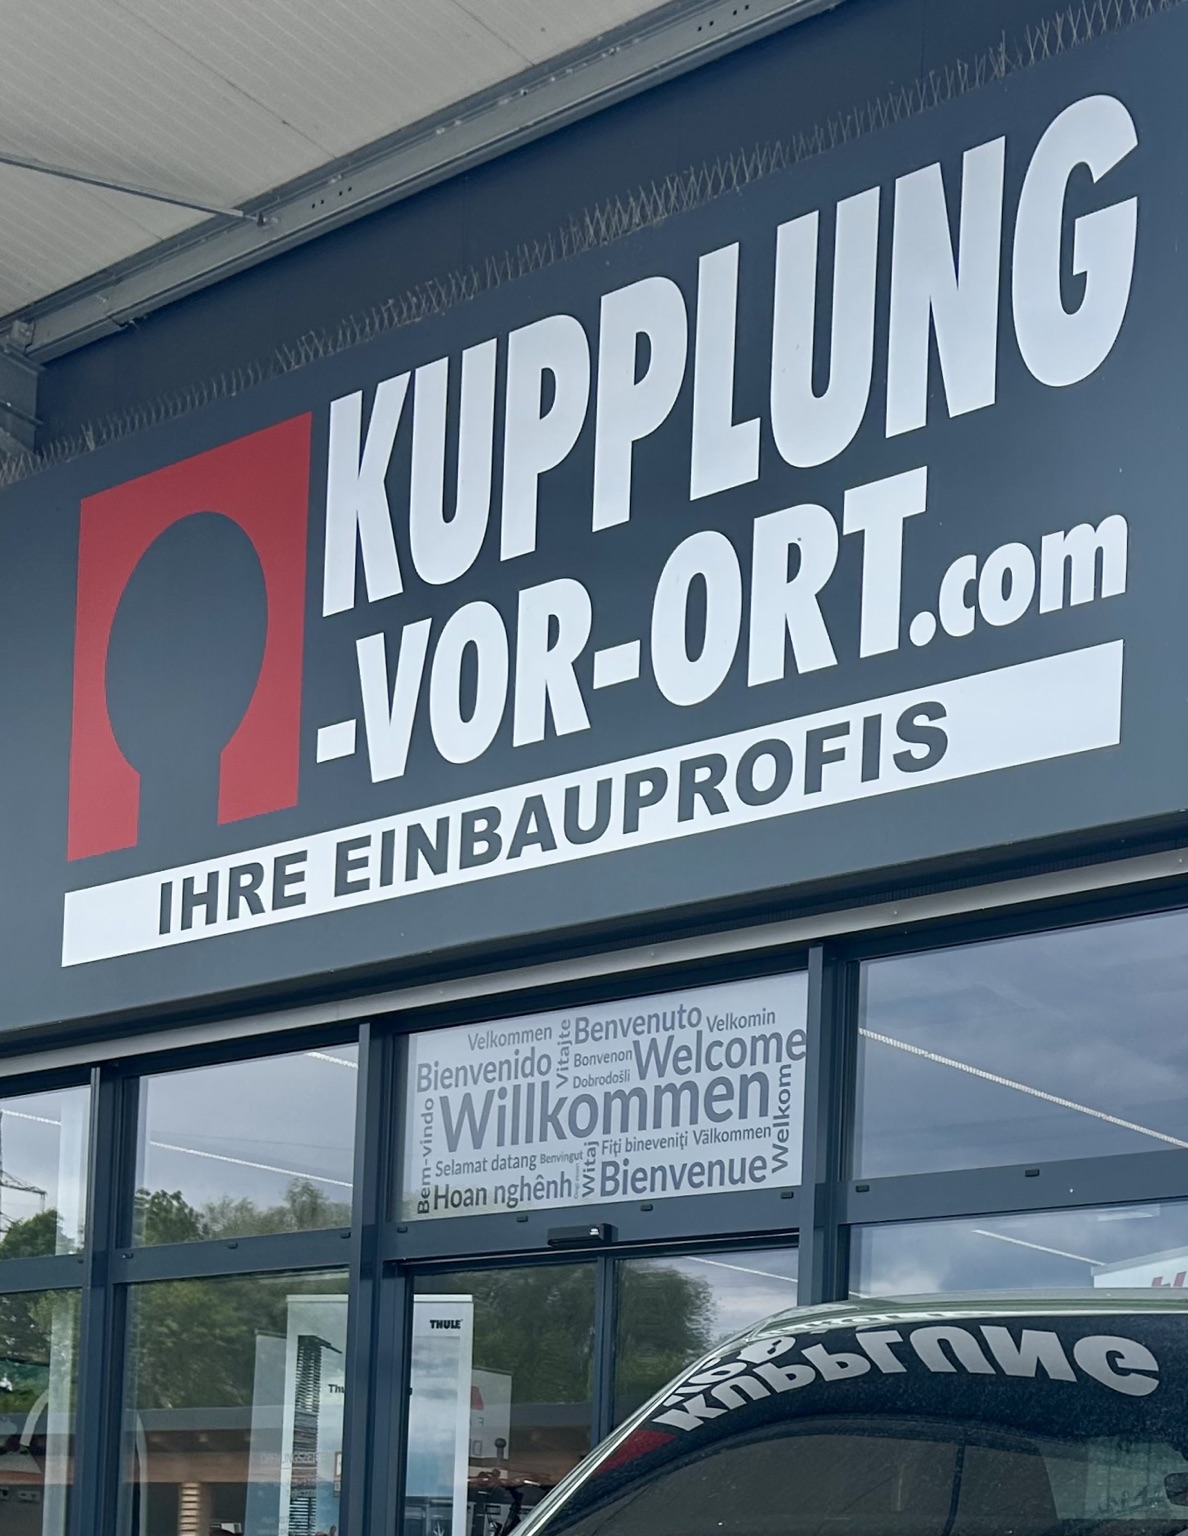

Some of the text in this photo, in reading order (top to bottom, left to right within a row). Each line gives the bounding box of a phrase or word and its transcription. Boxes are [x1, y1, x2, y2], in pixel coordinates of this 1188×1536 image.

[322, 94, 1138, 617] KUPPLUNG
[316, 467, 1128, 783] -VOR-ORT.com
[157, 701, 949, 935] IHRE EINBAUPROFIS
[467, 1025, 553, 1051] Velkommen
[574, 1003, 702, 1045] Benvenuto
[706, 1008, 776, 1033] Velkomin
[416, 1046, 553, 1093] Bienvenido
[556, 1018, 573, 1090] Vitajte
[573, 1049, 633, 1068] Bonvenon
[632, 1028, 807, 1081] Welcome
[573, 1069, 631, 1089] Dobrodošli
[439, 1070, 770, 1153] Willkommen
[771, 1063, 792, 1174] Welkom
[417, 1097, 435, 1214] Bem-vindo
[692, 1125, 772, 1146] Välkommen
[435, 1154, 537, 1177] Selamat datang
[540, 1151, 584, 1164] Benvingut
[582, 1140, 600, 1198] Witaj
[600, 1155, 768, 1197] Bienvenue
[433, 1184, 488, 1210] Hoan
[493, 1171, 572, 1209] nghênh
[429, 1319, 462, 1330] THULE
